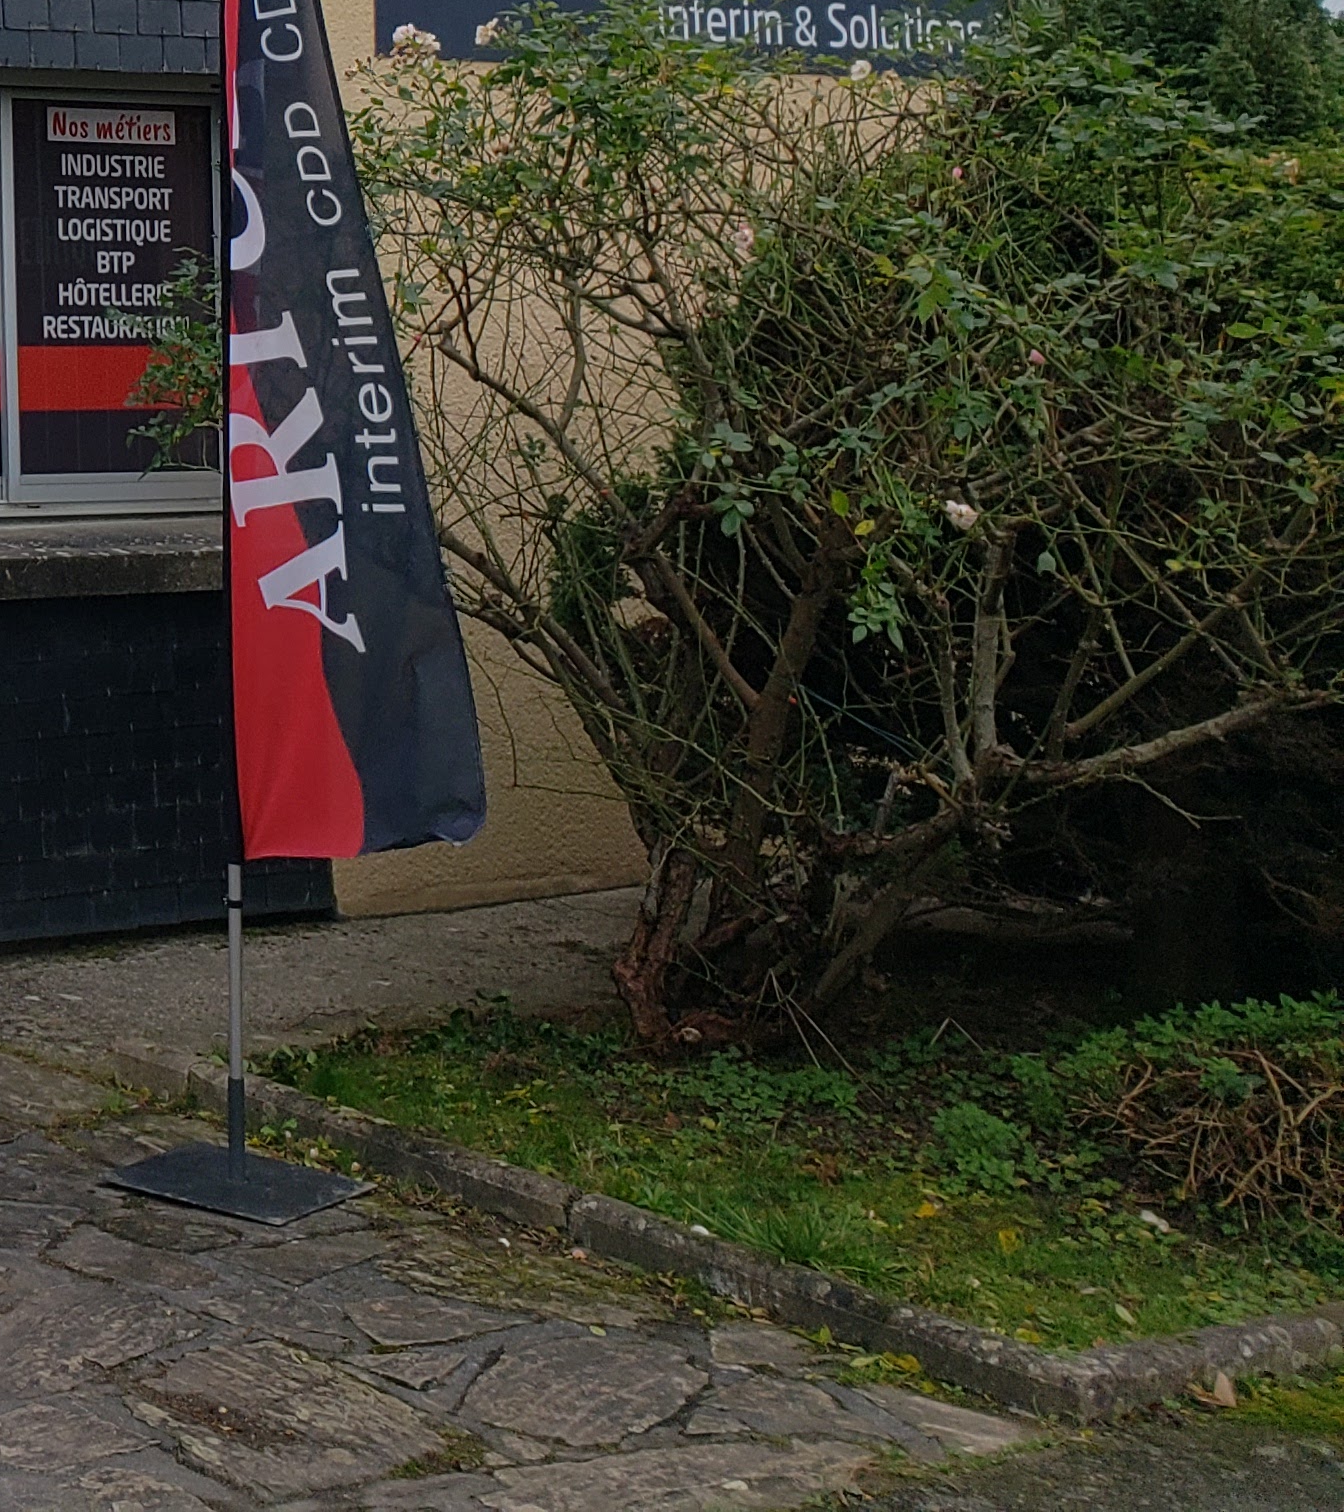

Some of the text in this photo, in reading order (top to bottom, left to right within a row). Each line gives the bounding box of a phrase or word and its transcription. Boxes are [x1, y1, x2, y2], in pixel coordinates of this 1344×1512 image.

[794, 5, 818, 47] &
[53, 112, 170, 141] Nos métiers
[61, 154, 164, 177] INDUSTRIE
[282, 100, 345, 228] CDD
[55, 186, 172, 210] TRANSPORT
[58, 219, 171, 245] LOGISTIQUE
[97, 252, 134, 273] BTP
[325, 267, 406, 515] interim
